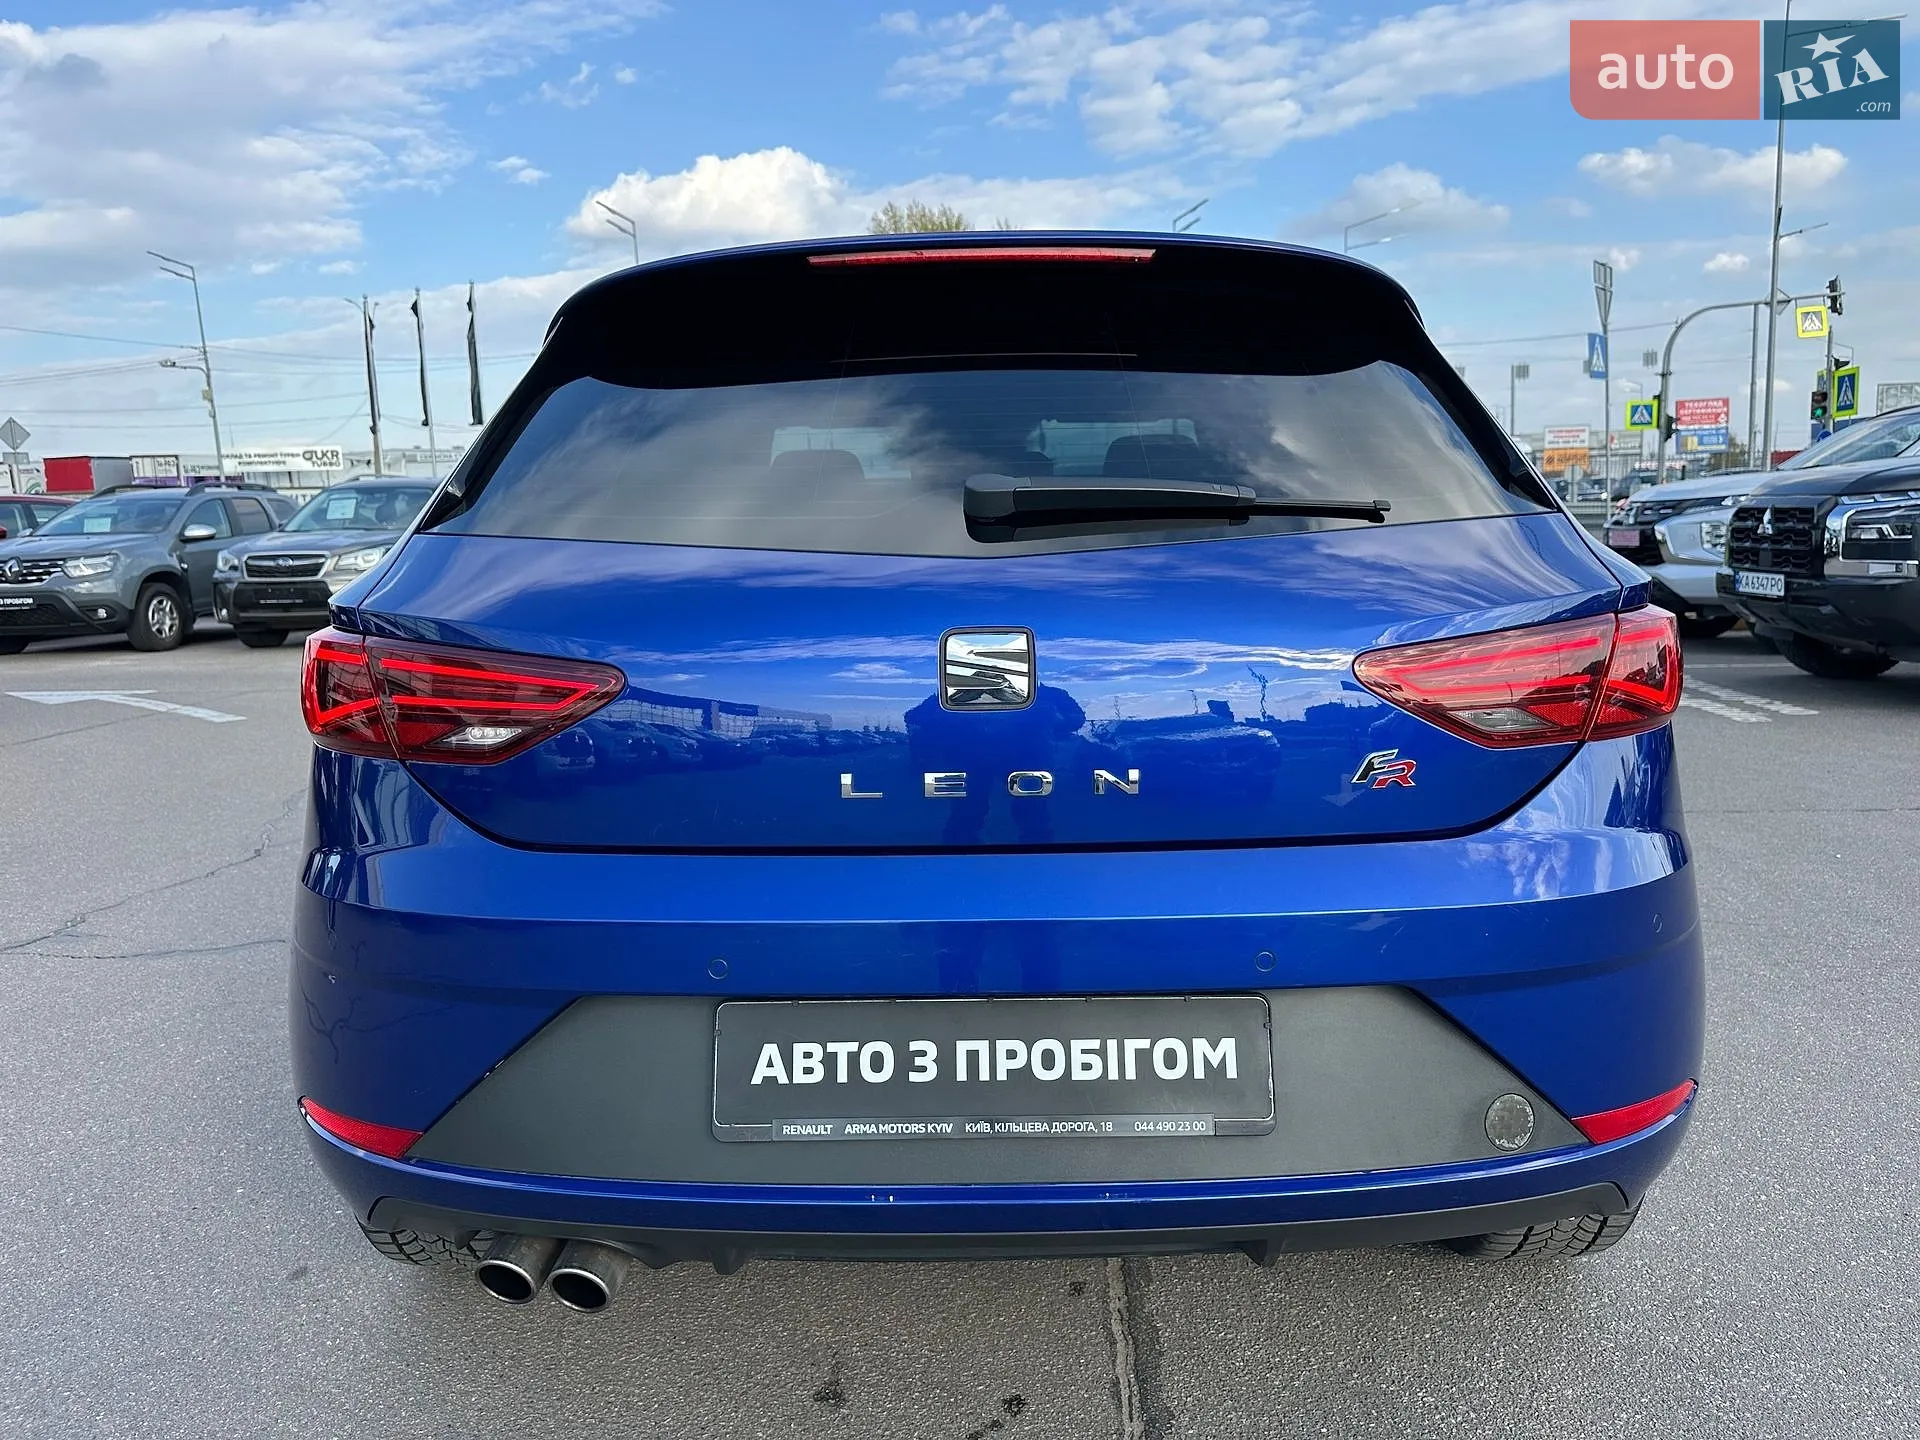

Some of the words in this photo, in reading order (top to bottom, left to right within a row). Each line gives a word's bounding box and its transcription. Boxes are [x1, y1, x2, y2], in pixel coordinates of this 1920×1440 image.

[840, 768, 1140, 798] LEON
[1350, 748, 1417, 790] FR
[750, 1040, 895, 1086] АВТО
[954, 1036, 1239, 1082] ПРОБІГОМ
[782, 1124, 834, 1135] RENAULT
[844, 1123, 878, 1135] ARMA
[878, 1123, 926, 1134] MOTORS
[927, 1122, 953, 1134] KYIV
[965, 1120, 993, 1135] КИЇВ,
[994, 1121, 1049, 1134] КІЛЬЦЕВА
[1050, 1121, 1098, 1135] ДОРОГА,
[1100, 1121, 1113, 1132] 18
[1134, 1120, 1154, 1132] 044
[1156, 1120, 1176, 1131] 490
[1178, 1120, 1191, 1131] 23
[1193, 1120, 1207, 1131] 00
